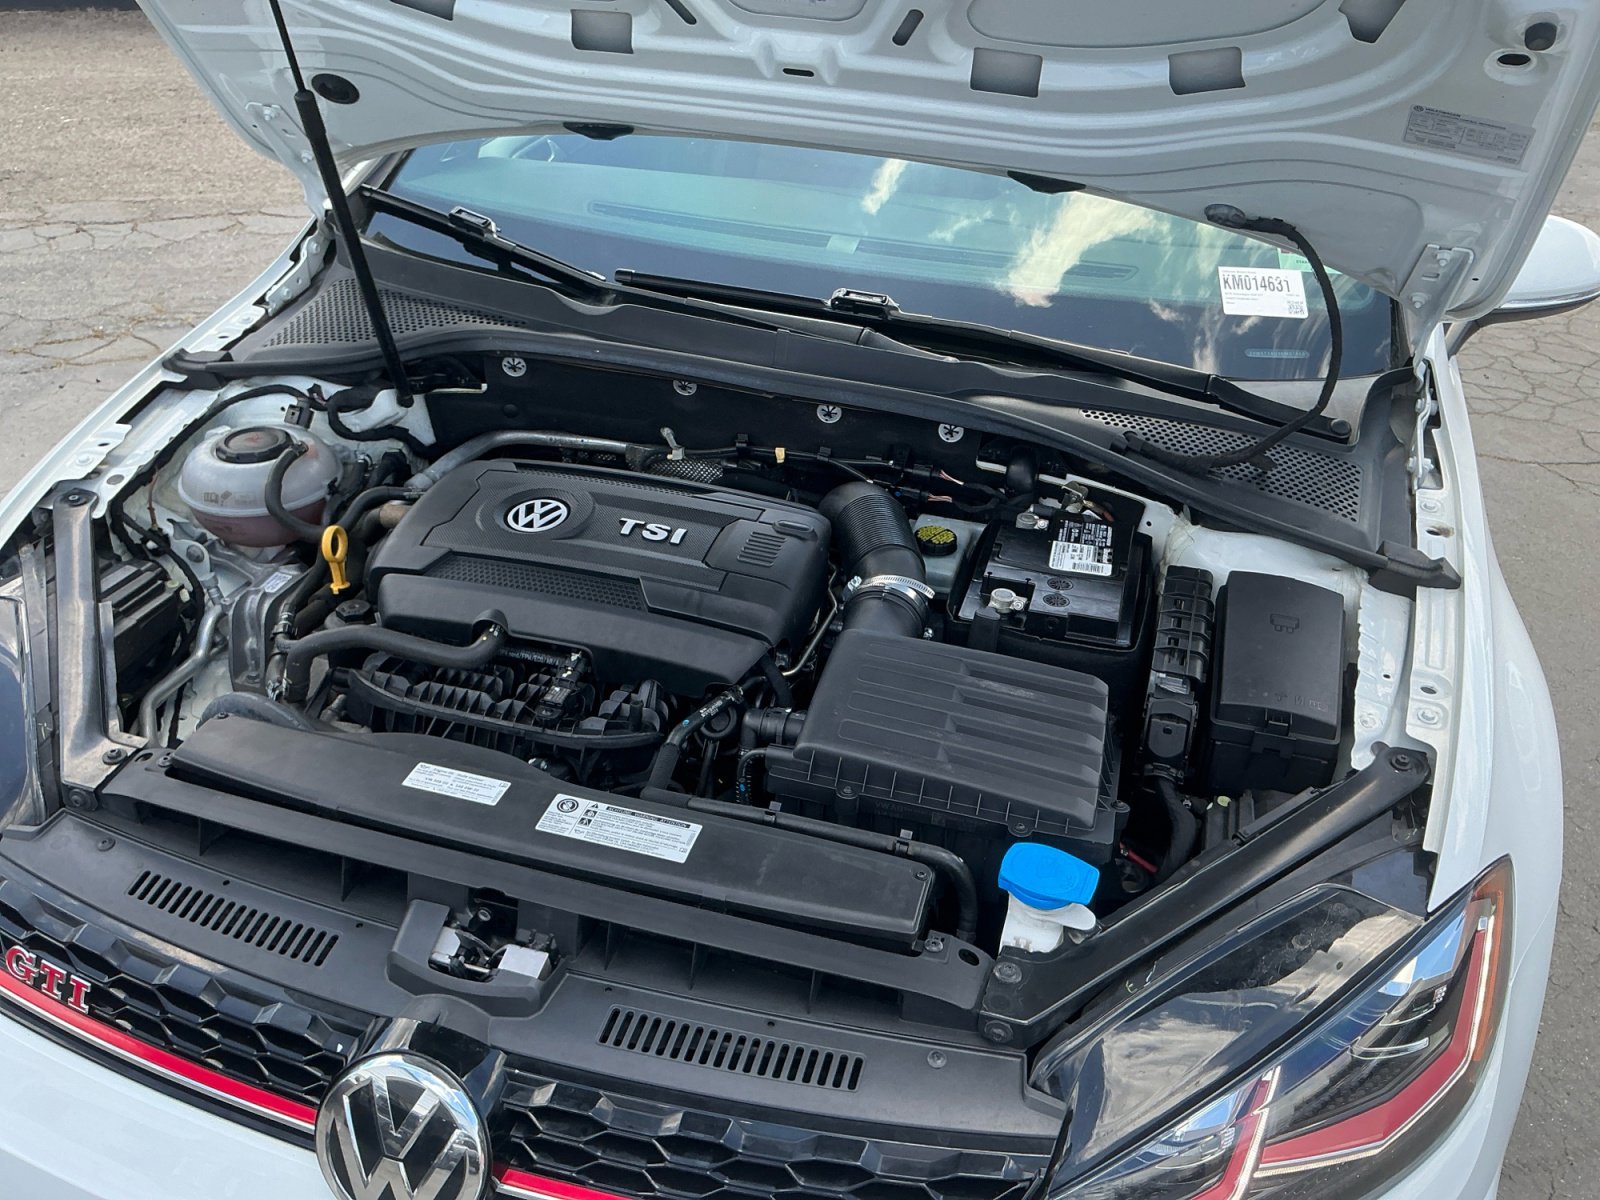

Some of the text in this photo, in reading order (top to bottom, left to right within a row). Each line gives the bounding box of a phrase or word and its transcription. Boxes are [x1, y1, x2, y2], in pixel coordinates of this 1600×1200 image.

[1222, 274, 1291, 293] KM014631
[618, 517, 688, 546] TSI
[5, 945, 92, 1015] GTI
